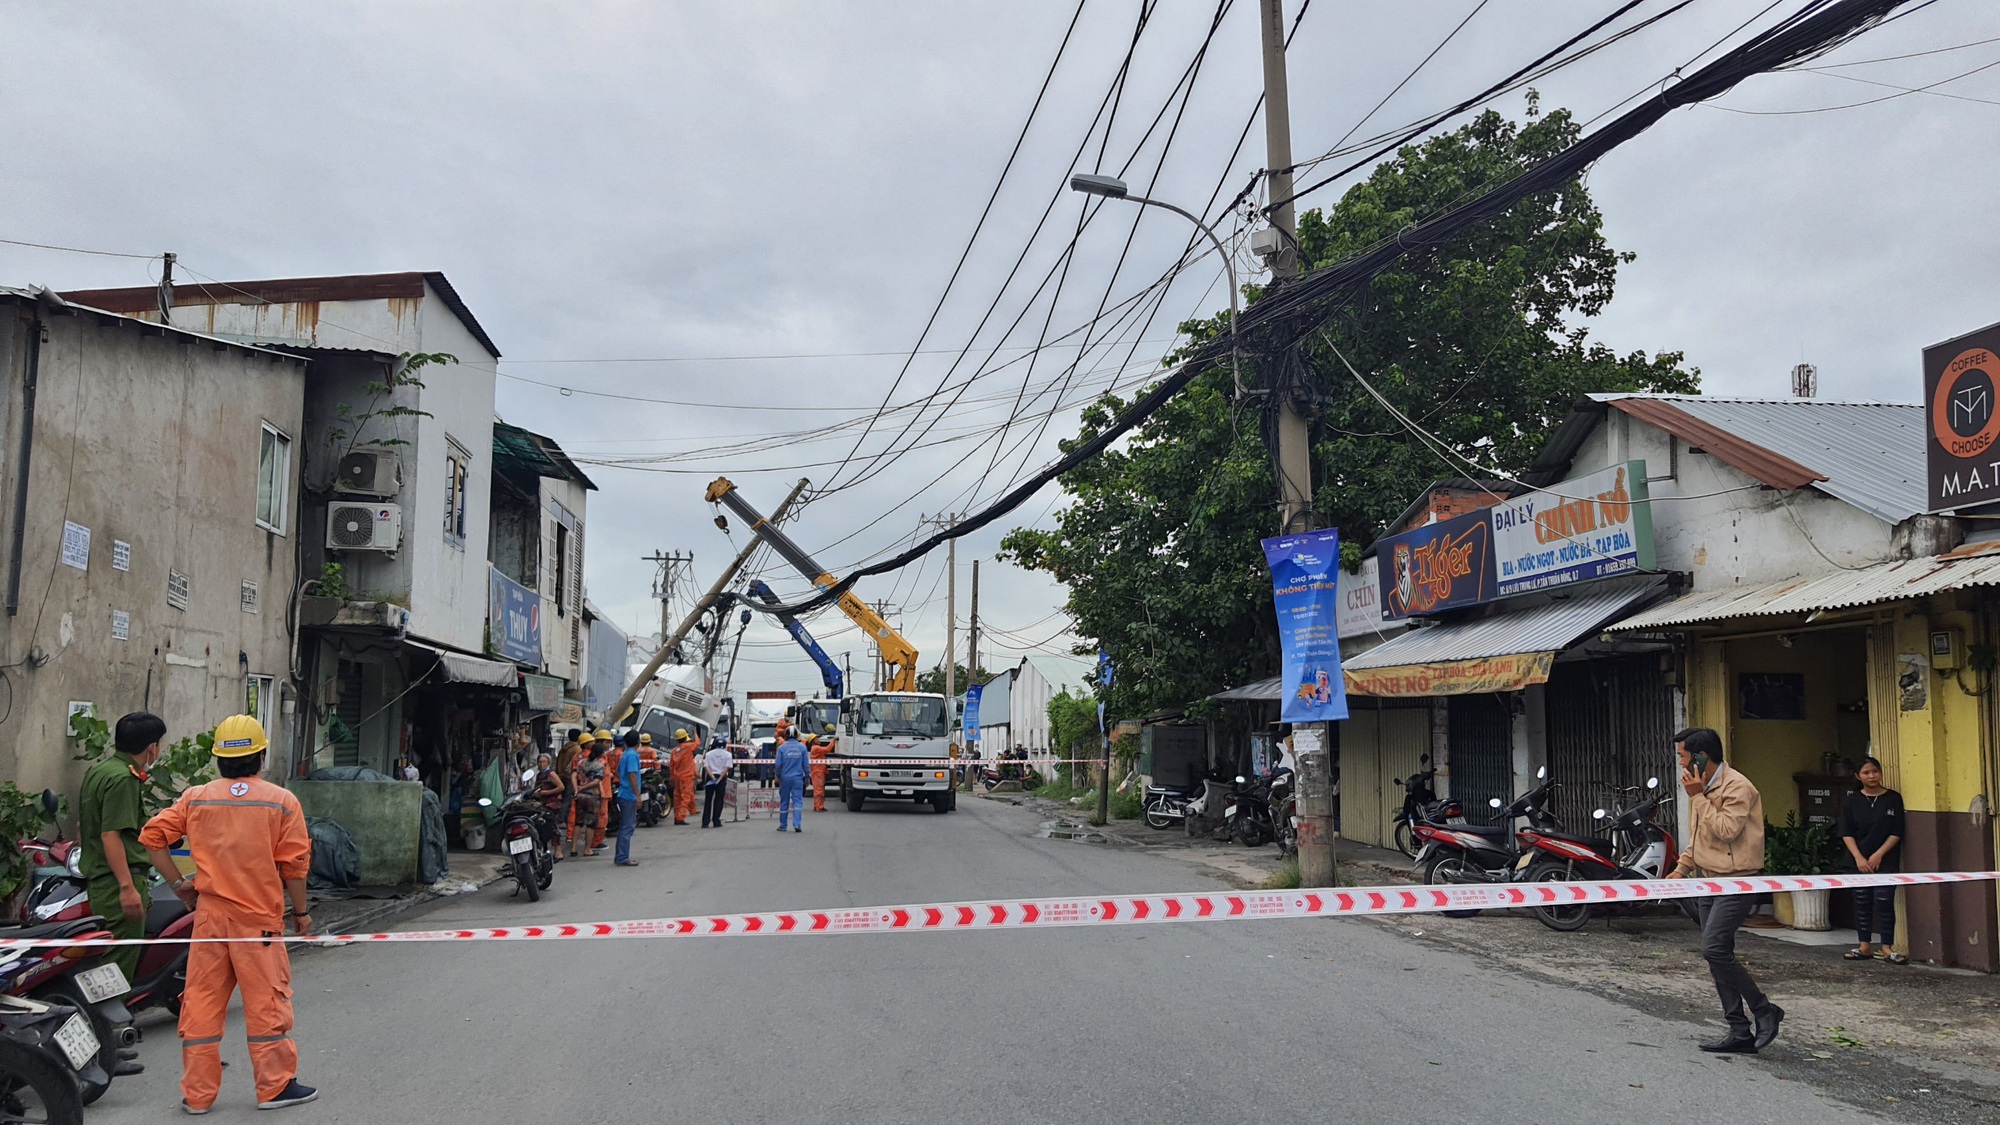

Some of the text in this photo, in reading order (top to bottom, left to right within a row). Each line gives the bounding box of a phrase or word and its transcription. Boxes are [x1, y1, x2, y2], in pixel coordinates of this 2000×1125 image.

[1952, 352, 1988, 373] COFFEE
[1952, 432, 1990, 454] CHOOSE
[1495, 498, 1534, 533] ĐẠI LÝ
[1535, 467, 1630, 545] CHÍNH NỔ
[1414, 533, 1473, 599] Tiger
[1516, 552, 1536, 573] NƯỚC
[1536, 550, 1556, 571] NGỌT
[1559, 542, 1580, 564] NƯỚC
[1580, 537, 1592, 559] ĐÁ
[1613, 528, 1631, 550] HÓA
[1276, 584, 1308, 596] KHÔNG
